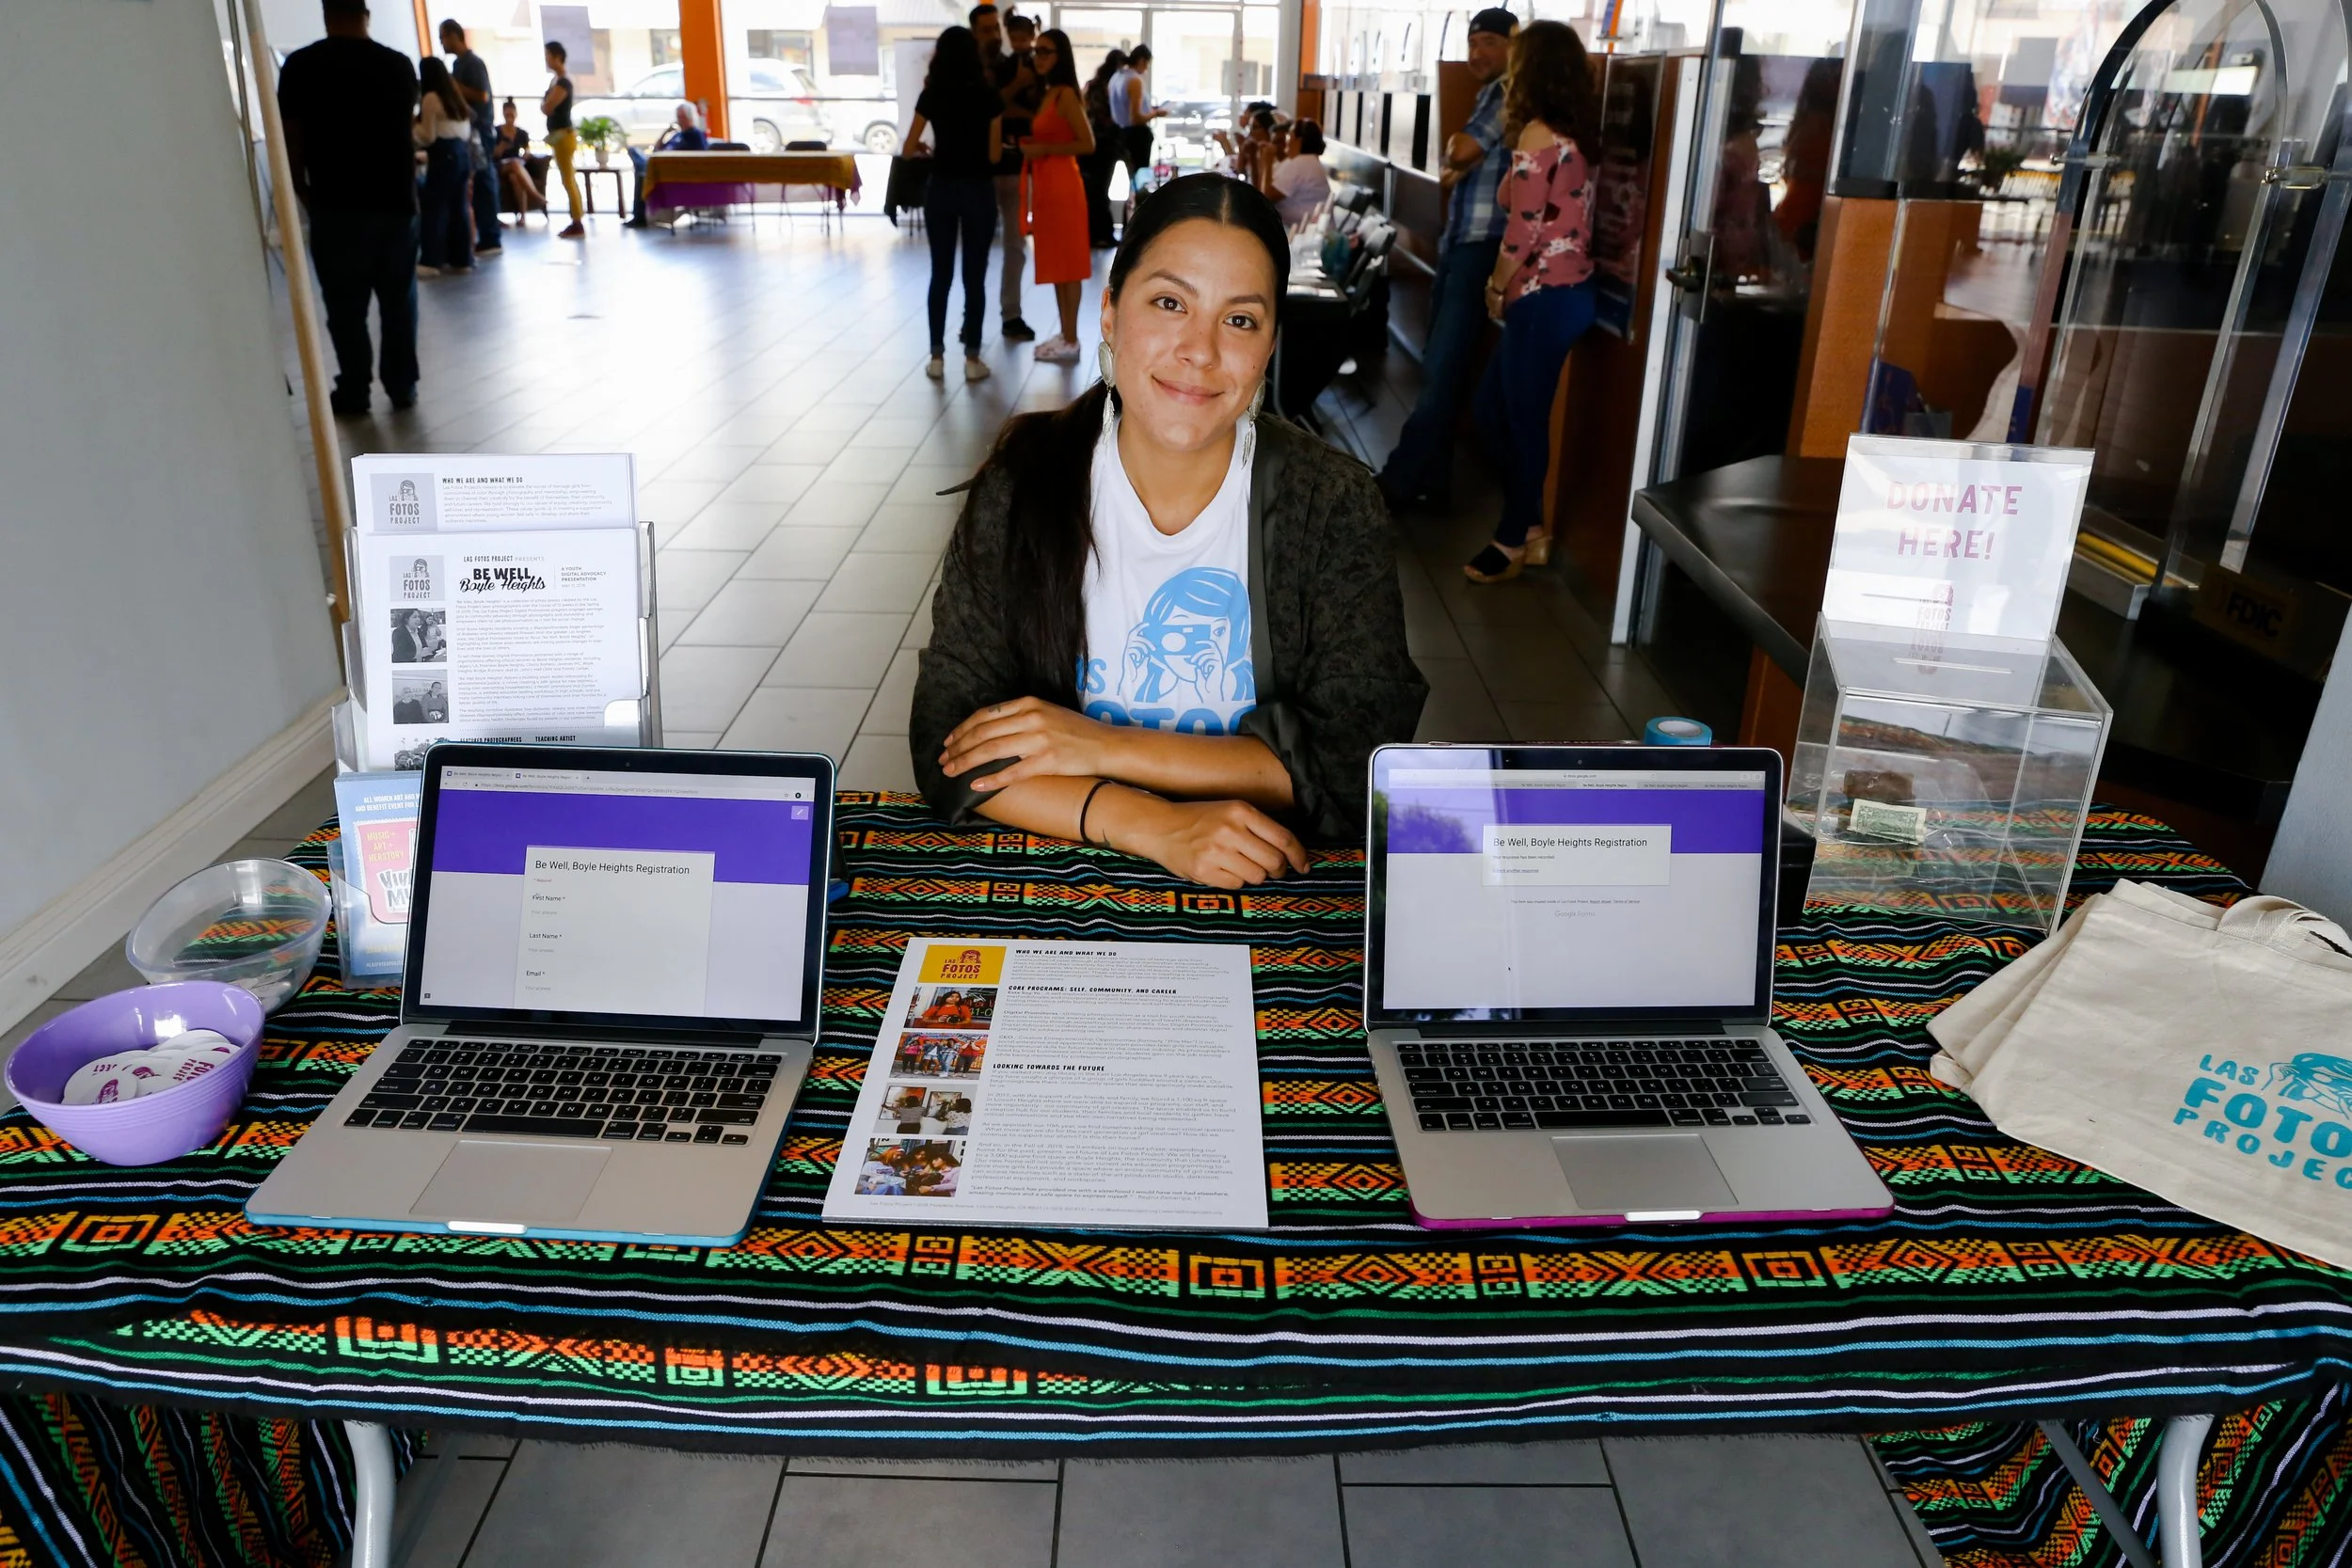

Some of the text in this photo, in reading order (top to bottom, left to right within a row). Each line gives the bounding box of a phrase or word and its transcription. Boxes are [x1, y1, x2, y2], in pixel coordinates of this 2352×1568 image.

[1886, 481, 2023, 515] DONATE
[390, 503, 420, 516] FOTOS
[1898, 528, 1995, 561] HERE!
[473, 568, 490, 580] BE
[403, 579, 430, 591] FOTOS
[460, 575, 546, 594] Boyle Heights
[367, 832, 389, 841] MUSIC
[374, 841, 387, 851] ART
[1493, 838, 1648, 848] Be Well, Boyle Heights Registration
[369, 851, 404, 863] HERSTORY
[535, 860, 690, 875] Be Well, Boyle Heights Registration
[379, 869, 413, 889] VIV
[942, 964, 981, 973] FOTOS
[2199, 1053, 2260, 1086] LAS
